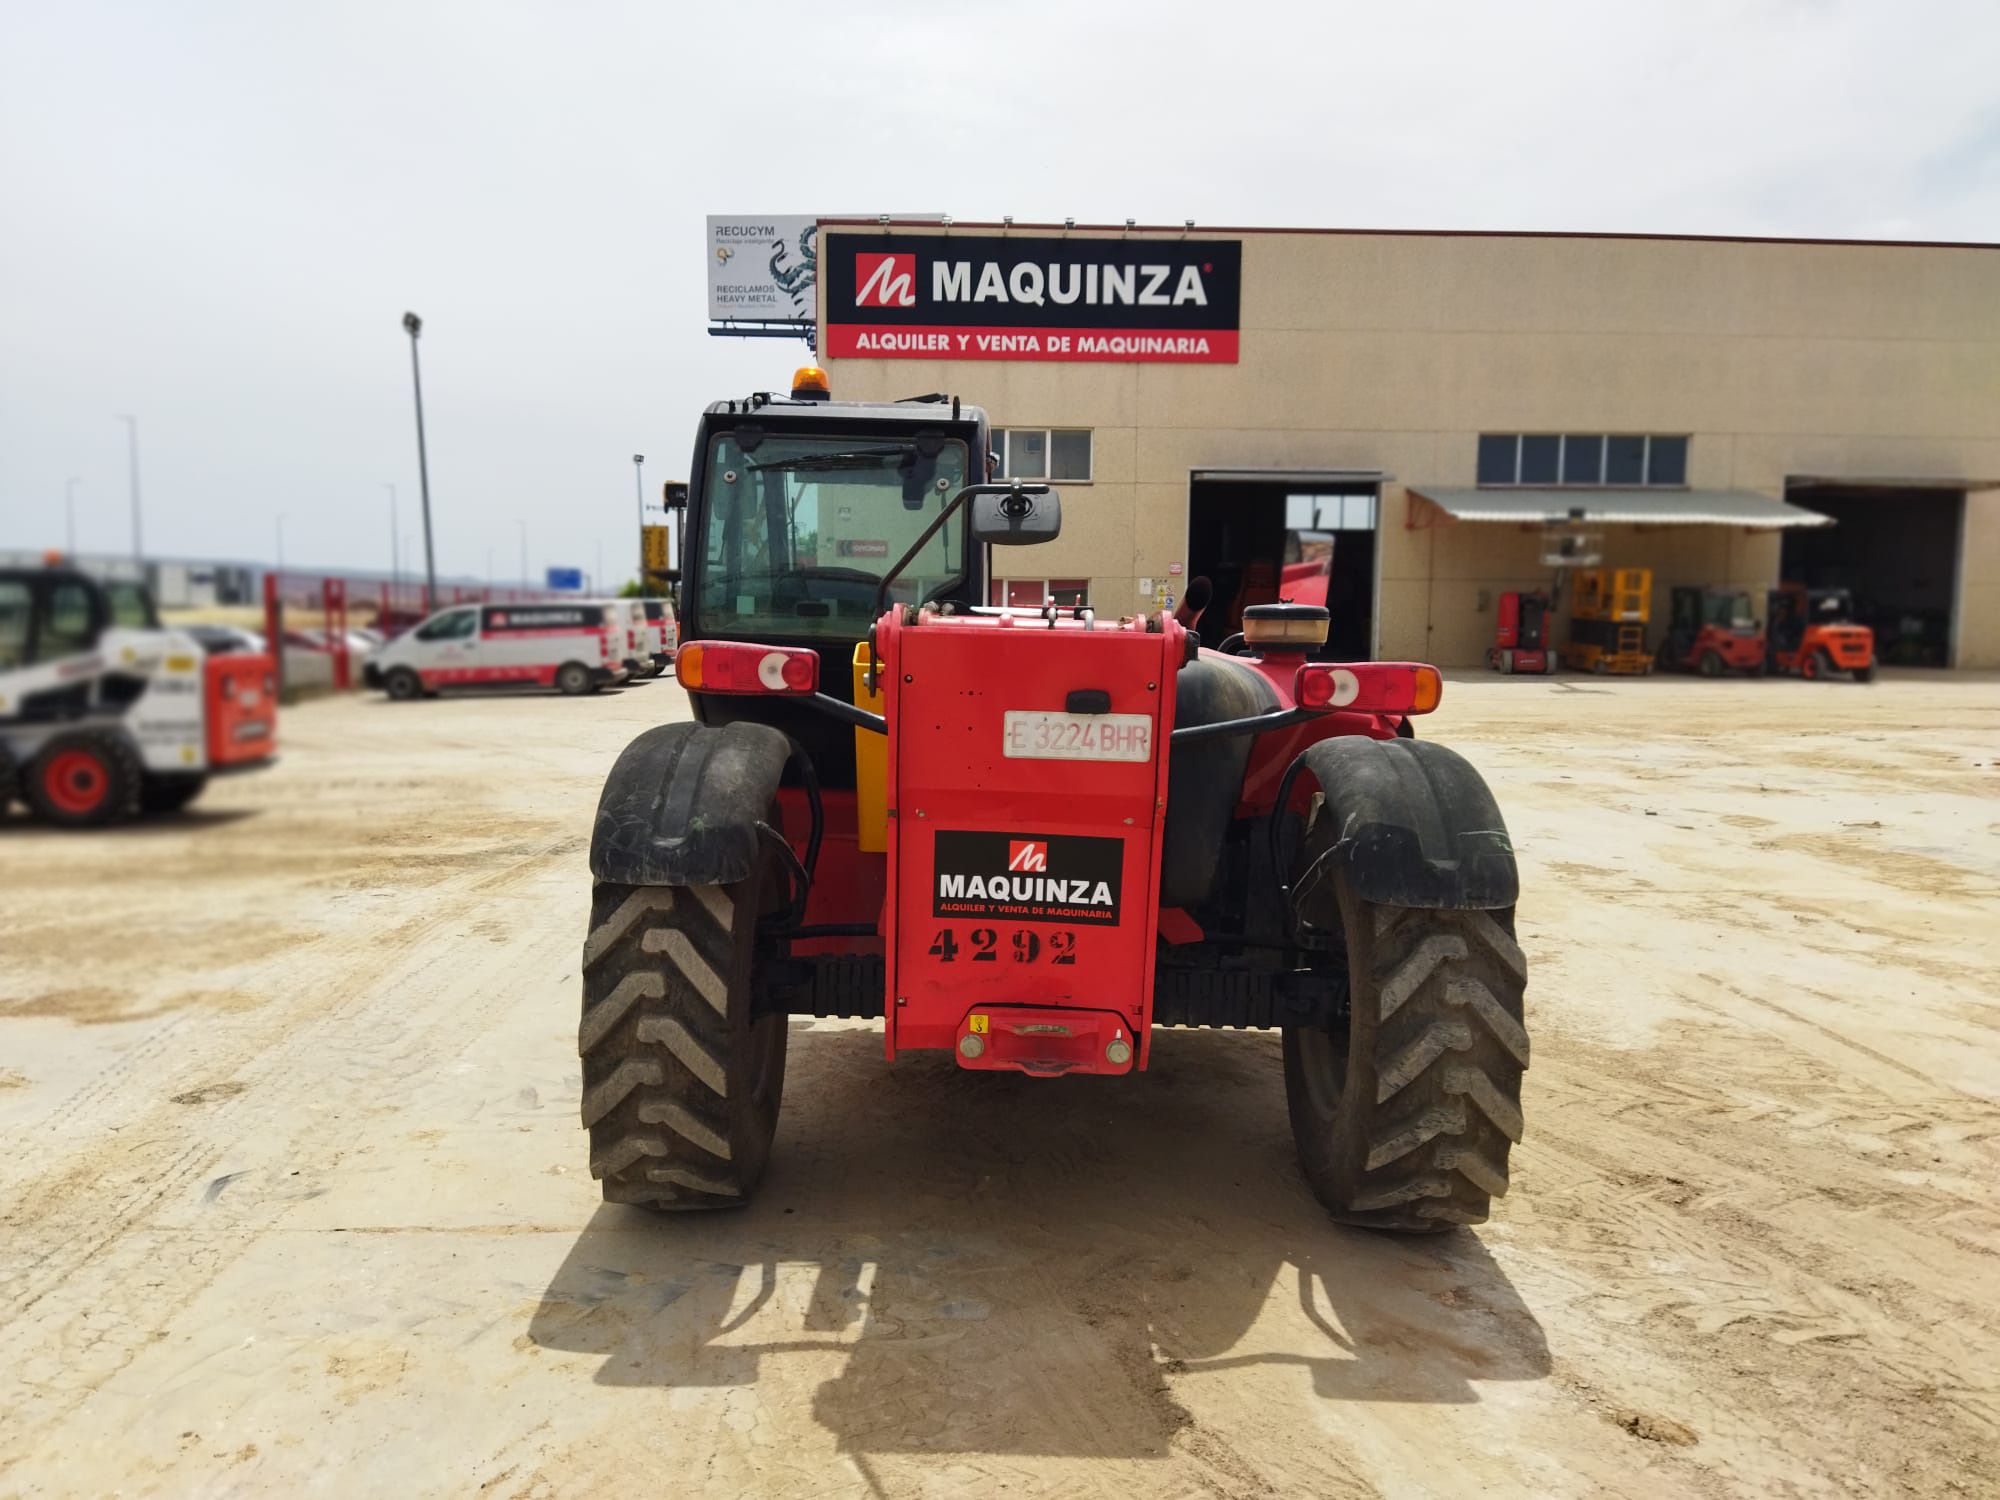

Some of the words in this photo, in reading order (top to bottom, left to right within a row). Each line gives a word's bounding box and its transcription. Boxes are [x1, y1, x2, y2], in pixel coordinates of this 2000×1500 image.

[715, 225, 775, 236] RECUCYM
[716, 285, 775, 293] RECICLAMOS
[716, 294, 746, 302] HEAVY
[748, 294, 777, 302] METAL
[855, 332, 950, 350] ALQUILER
[956, 334, 970, 351] Y
[976, 335, 1041, 352] VENTA
[1047, 336, 1071, 353] DE
[1077, 336, 1210, 354] MAQUINARIA
[939, 874, 1113, 906] MAQUINZA
[940, 903, 986, 912] ALQUILER
[988, 905, 995, 913] Y
[998, 905, 1029, 914] VENTA
[1032, 907, 1044, 915] DE
[1046, 907, 1113, 919] MAQUINARIA
[928, 928, 1077, 965] 4292
